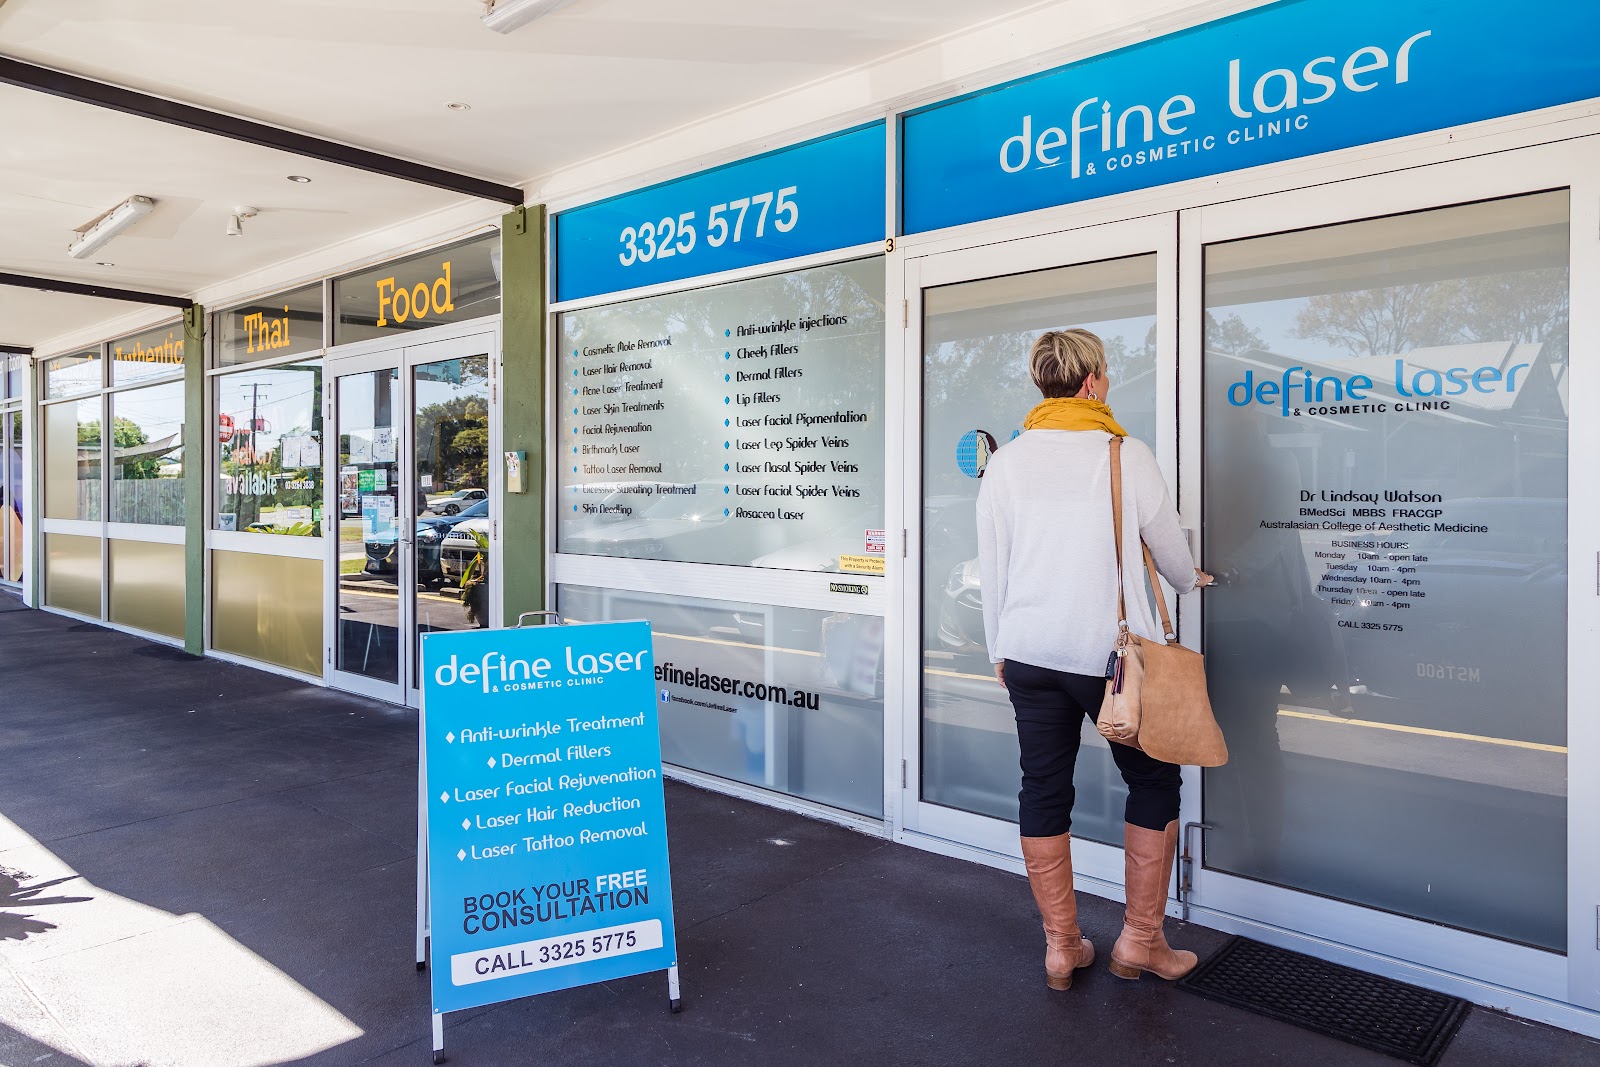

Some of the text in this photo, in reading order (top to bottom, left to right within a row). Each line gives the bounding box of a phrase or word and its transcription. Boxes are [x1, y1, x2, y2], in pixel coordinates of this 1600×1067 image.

[999, 29, 1431, 179] define laser
[1086, 114, 1309, 175] & COSMETIC CLINIC
[619, 186, 798, 266] 3325 5775
[886, 238, 894, 252] 3
[244, 261, 454, 353] Thai Food
[737, 315, 847, 337] Anti-wrinkle injections
[583, 336, 671, 357] Cosmetic Mole Removal
[737, 344, 798, 359] Cheek Fillers
[583, 359, 652, 376] Laser Hair Removal
[737, 367, 802, 382] Dermal Fillers
[583, 379, 663, 395] Acne Laser Treatment
[1227, 359, 1529, 417] define laser
[737, 392, 780, 406] Lip Fillers
[583, 400, 664, 415] Laser Skin Treatments
[1294, 400, 1450, 416] & COSMETIC CLINIC
[736, 411, 867, 427] Laser Facial Pigmentation
[583, 423, 652, 435] Facial Rejuvenation
[583, 444, 640, 455] Birthmark Laser
[736, 436, 849, 451] Laser Leg Spider Veins
[583, 463, 662, 474] Tattoo Laser Removal
[736, 460, 858, 475] Laser Nasal Spider Veins
[227, 470, 277, 496] available
[617, 484, 652, 496] Sweating
[655, 484, 696, 495] Treatment
[736, 484, 860, 499] Laser Facial Spider Veins
[1300, 490, 1442, 505] Dr Lindsay Watson
[583, 504, 632, 516] Skin Needling
[736, 507, 805, 520] Rosacea Laser
[1300, 508, 1442, 518] BMedSci MBBS FRACGP
[1260, 521, 1488, 533] Australasian College of Aesthetic Medicine
[1315, 552, 1345, 560] Monday
[1326, 563, 1357, 572] Tuesday
[1397, 566, 1415, 574] 4pm
[1321, 574, 1367, 584] Wednesday
[1402, 578, 1420, 586] 4pm
[838, 585, 860, 593] SMOKING
[1317, 585, 1353, 594] Thursday
[1331, 597, 1355, 606] Friday
[1392, 601, 1410, 609] 4pm
[1361, 622, 1380, 630] 3325
[435, 646, 648, 694] define laser
[504, 680, 562, 692] COSMETIC
[567, 677, 604, 686] CLINIC
[654, 663, 819, 710] efinelaser.com.au
[461, 712, 645, 743] Anti-wrinkle Treatment
[502, 745, 611, 768] Dermal Fillers
[455, 767, 656, 802] Laser Facial Rejuvenation
[476, 798, 640, 829] Laser Hair Reduction
[471, 821, 648, 860] Laser Tattoo Removal
[463, 869, 647, 913] BOOK YOUR FREE
[463, 886, 649, 934] CONSULTATION
[475, 931, 636, 975] CALL 3325 5775
